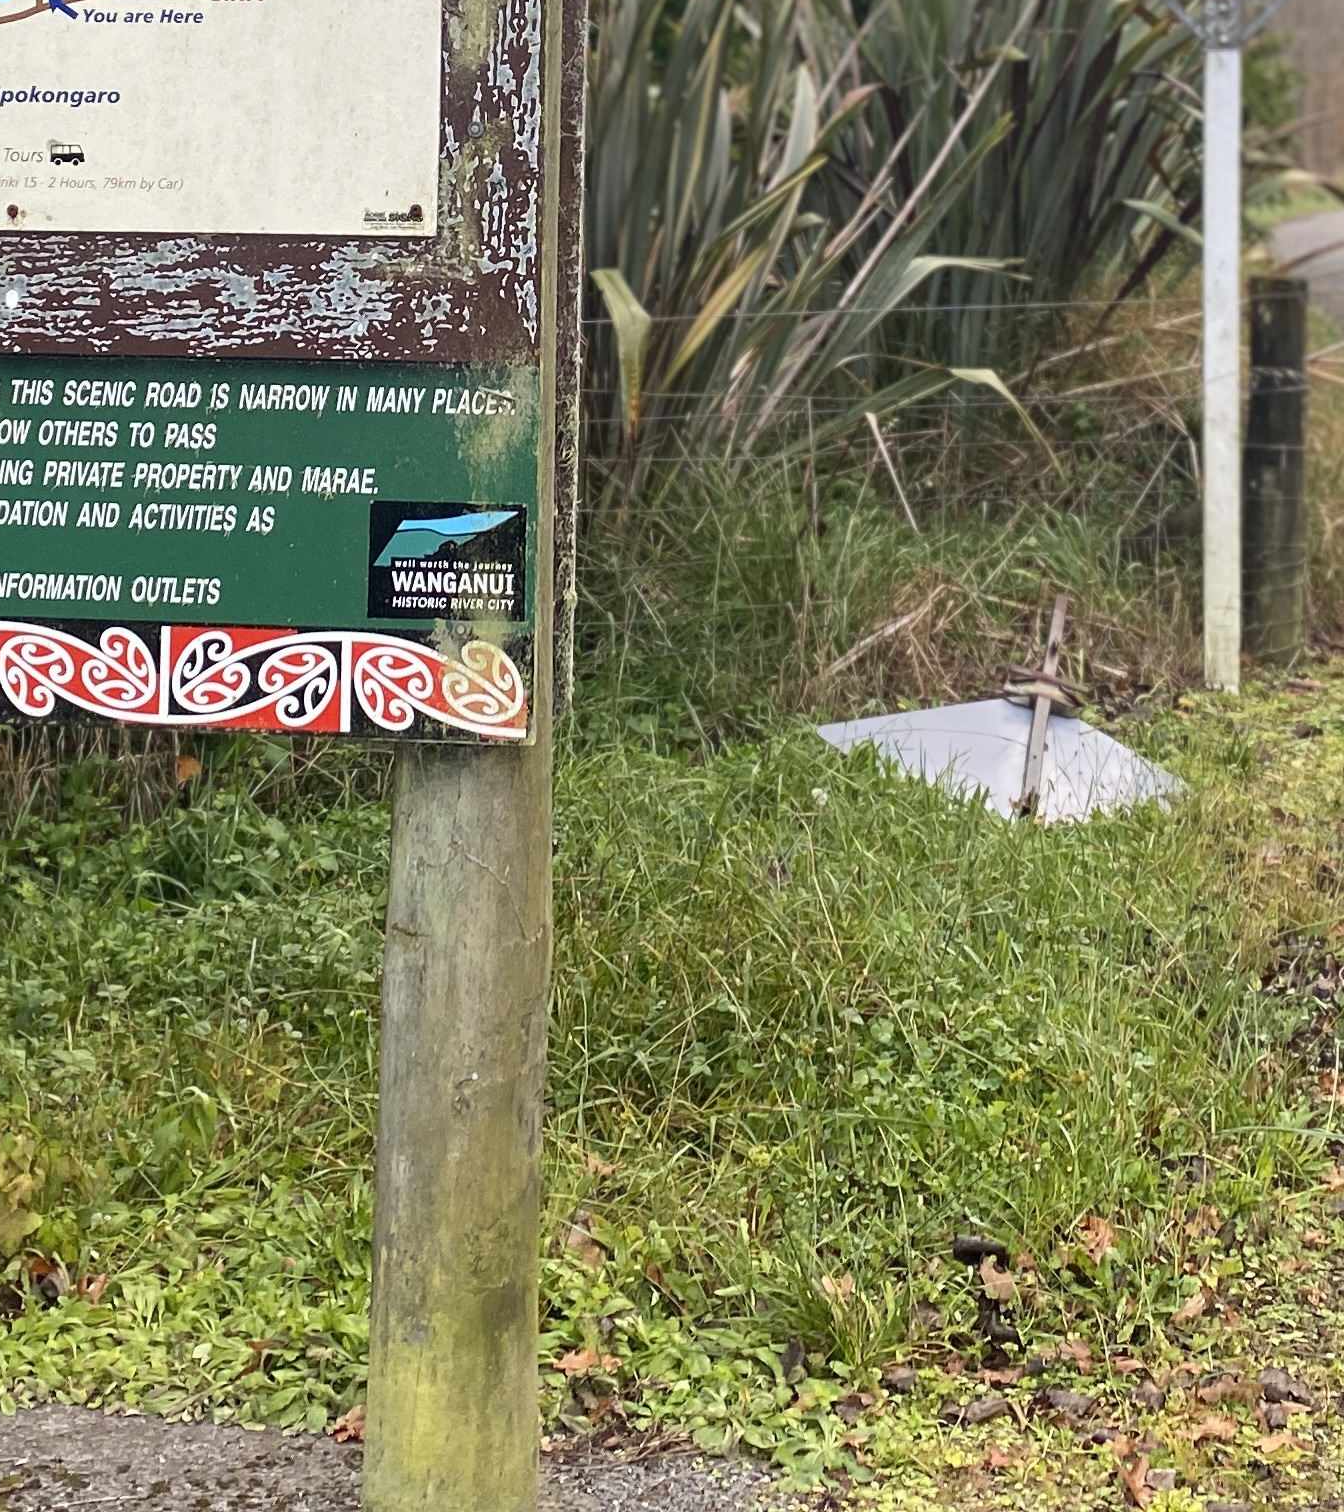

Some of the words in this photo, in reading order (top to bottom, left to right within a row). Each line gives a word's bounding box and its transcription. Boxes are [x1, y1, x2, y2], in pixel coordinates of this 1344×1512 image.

[83, 9, 119, 24] You
[123, 12, 154, 24] are
[159, 10, 204, 24] Here
[4, 148, 43, 162] Tours
[10, 379, 54, 405] THIS
[63, 380, 139, 408] SCENIC
[146, 382, 202, 408] ROAD
[209, 383, 229, 409] IS
[238, 384, 329, 411] NARROW
[336, 386, 358, 412] IN
[366, 387, 425, 414] MANY
[76, 503, 119, 528] AND
[128, 503, 237, 531] ACTIVITIES
[245, 507, 275, 532] AS
[131, 576, 220, 603] OUTLETS
[392, 571, 515, 595] WANGANUI
[392, 596, 447, 609] HISTORIC
[451, 598, 484, 610] RIVER
[488, 599, 514, 611] CITY
